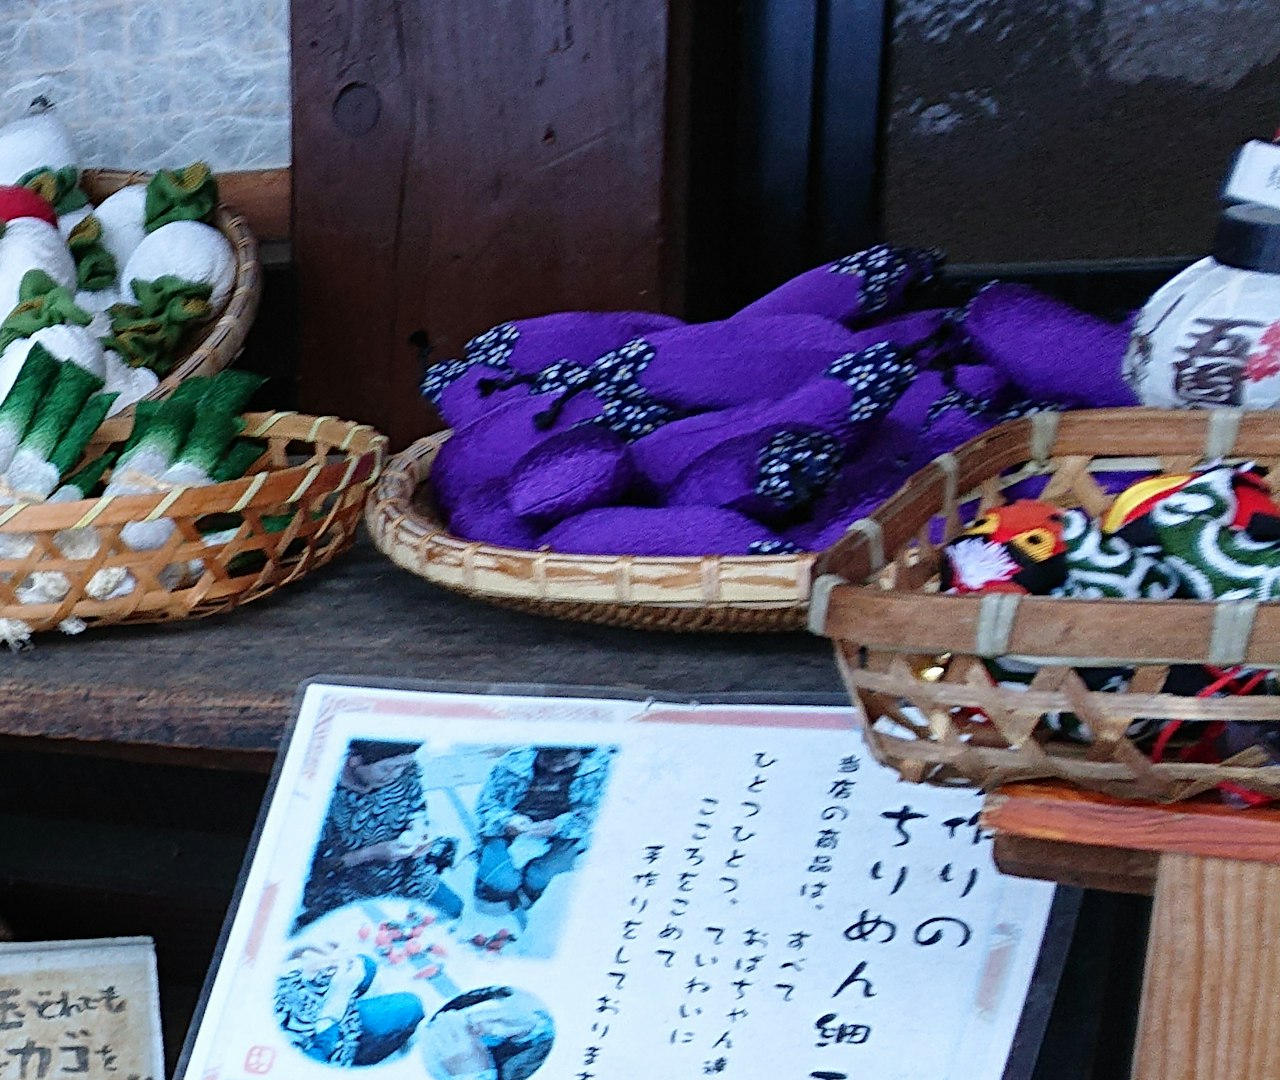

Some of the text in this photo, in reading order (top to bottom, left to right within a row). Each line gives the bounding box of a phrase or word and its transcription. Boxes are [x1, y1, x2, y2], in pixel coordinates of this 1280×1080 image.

[655, 798, 720, 969] こころをこめて
